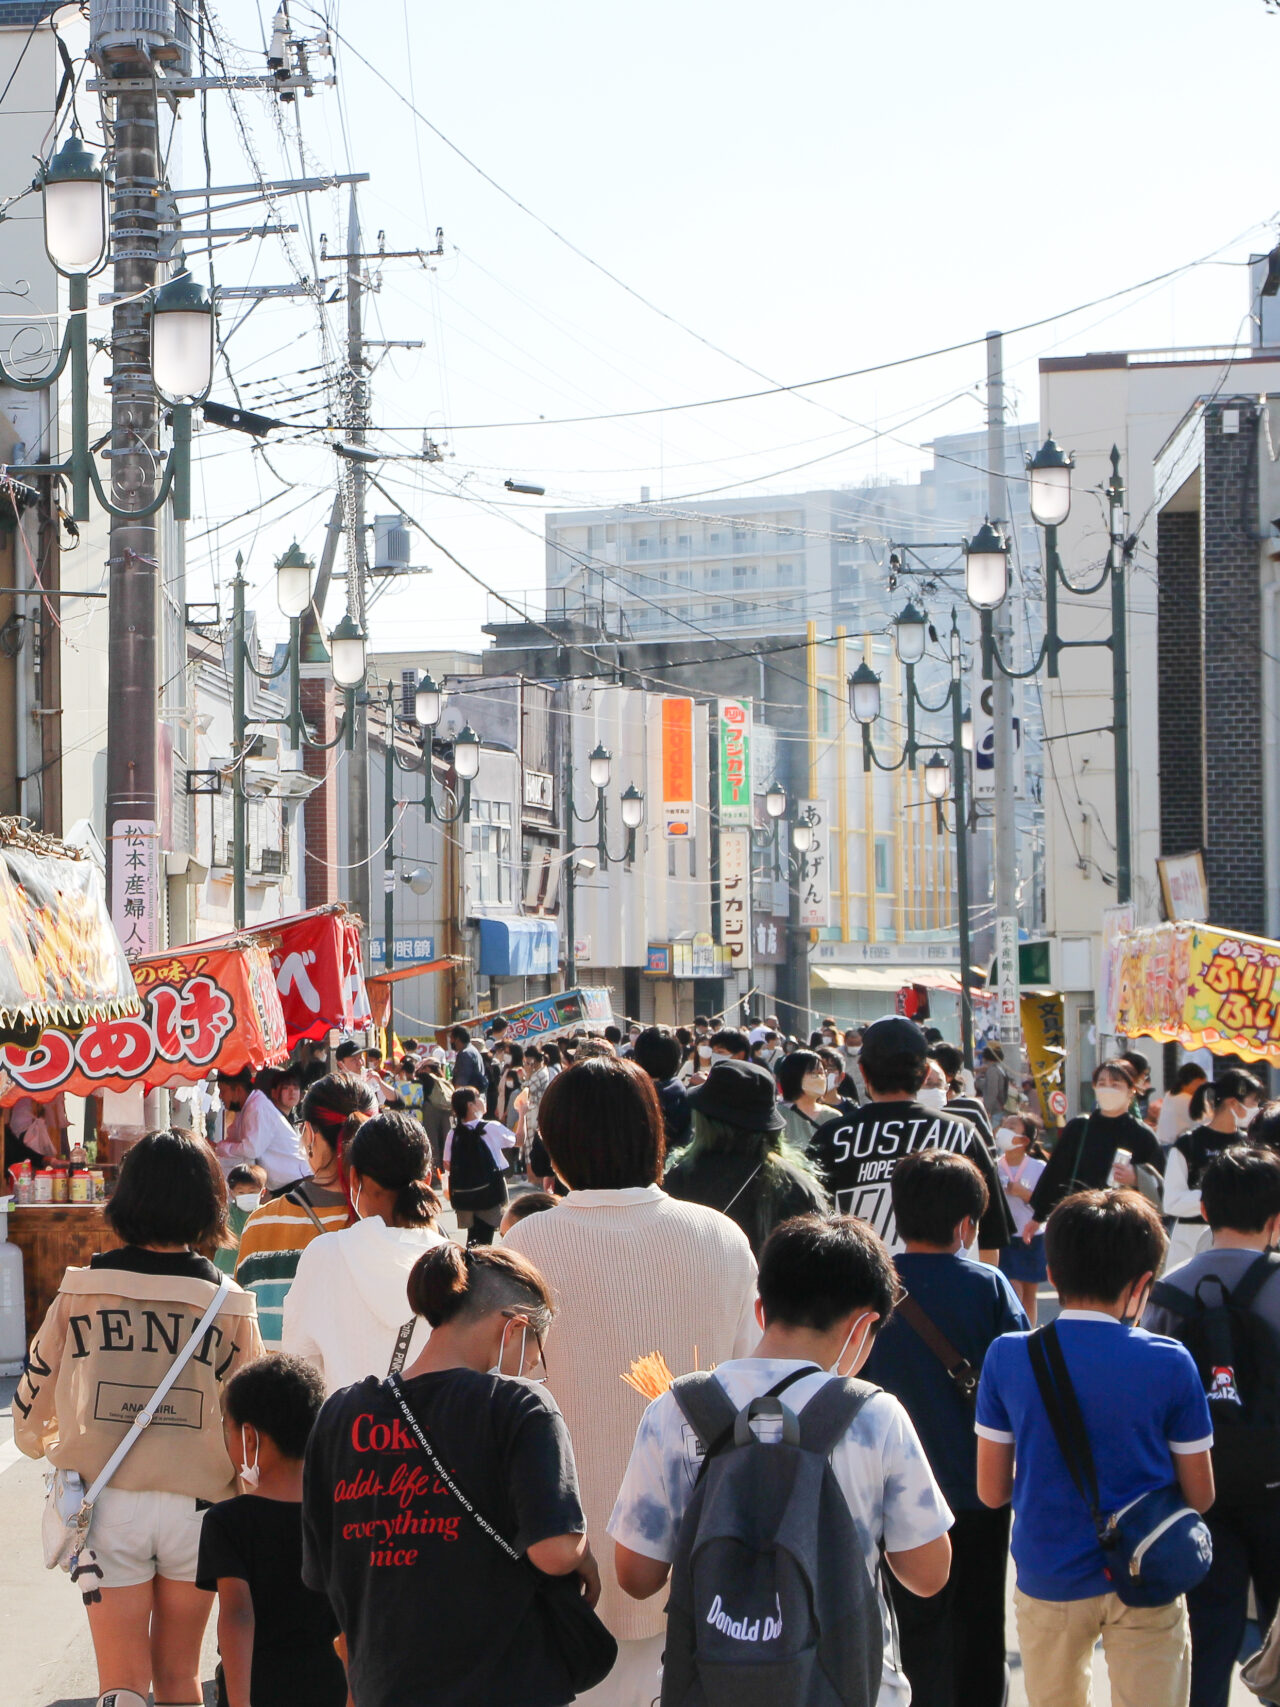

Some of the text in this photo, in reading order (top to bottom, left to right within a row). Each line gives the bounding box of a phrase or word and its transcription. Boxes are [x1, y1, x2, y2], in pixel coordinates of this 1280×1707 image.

[727, 729, 744, 800] フジカラー
[724, 874, 744, 957] ナカジマ
[833, 1118, 976, 1163] SUSTAIN
[706, 1594, 760, 1641] Donald
